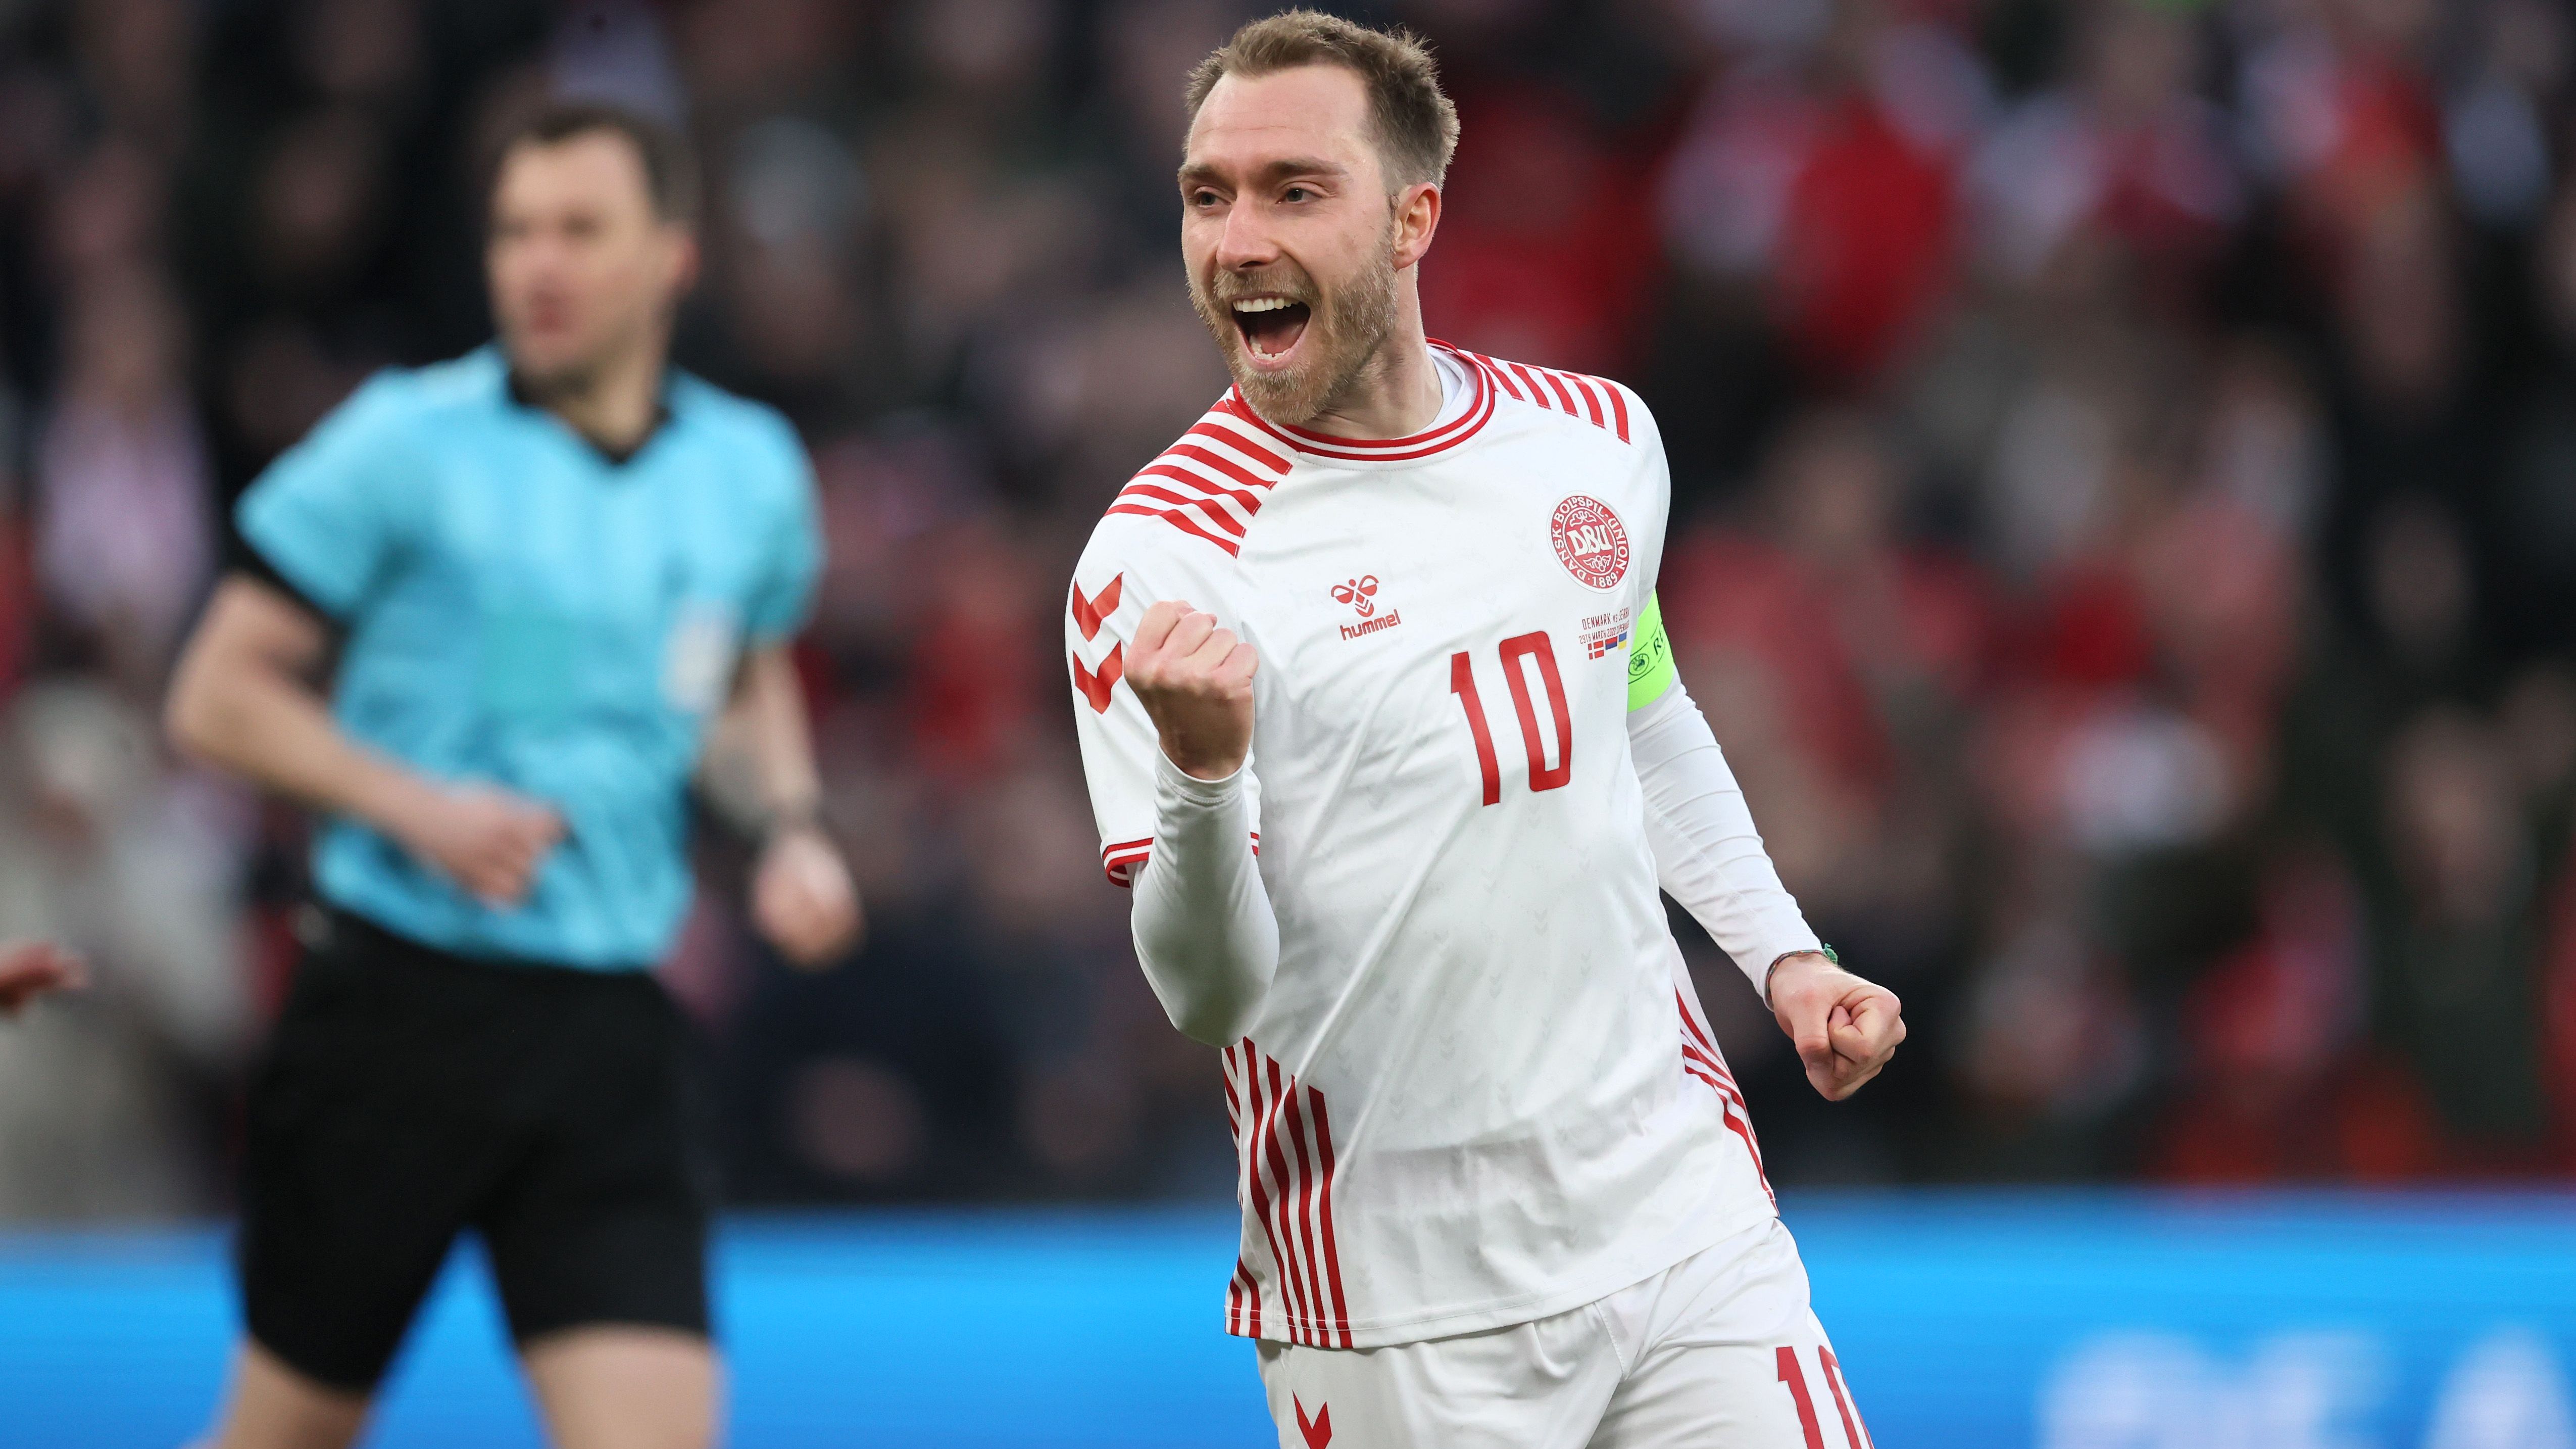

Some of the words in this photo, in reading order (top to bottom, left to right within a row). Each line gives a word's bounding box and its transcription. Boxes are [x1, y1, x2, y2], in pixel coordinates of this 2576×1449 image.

[1566, 524, 1613, 556] DBU
[1552, 528, 1588, 581] DANSK
[1592, 572, 1618, 588] 1889
[1340, 608, 1401, 641] hummel
[1579, 633, 1591, 644] 29TH
[1592, 629, 1606, 641] MARCH
[1607, 626, 1617, 637] 2022
[1581, 613, 1611, 630] DENMARK
[1451, 631, 1572, 807] 10
